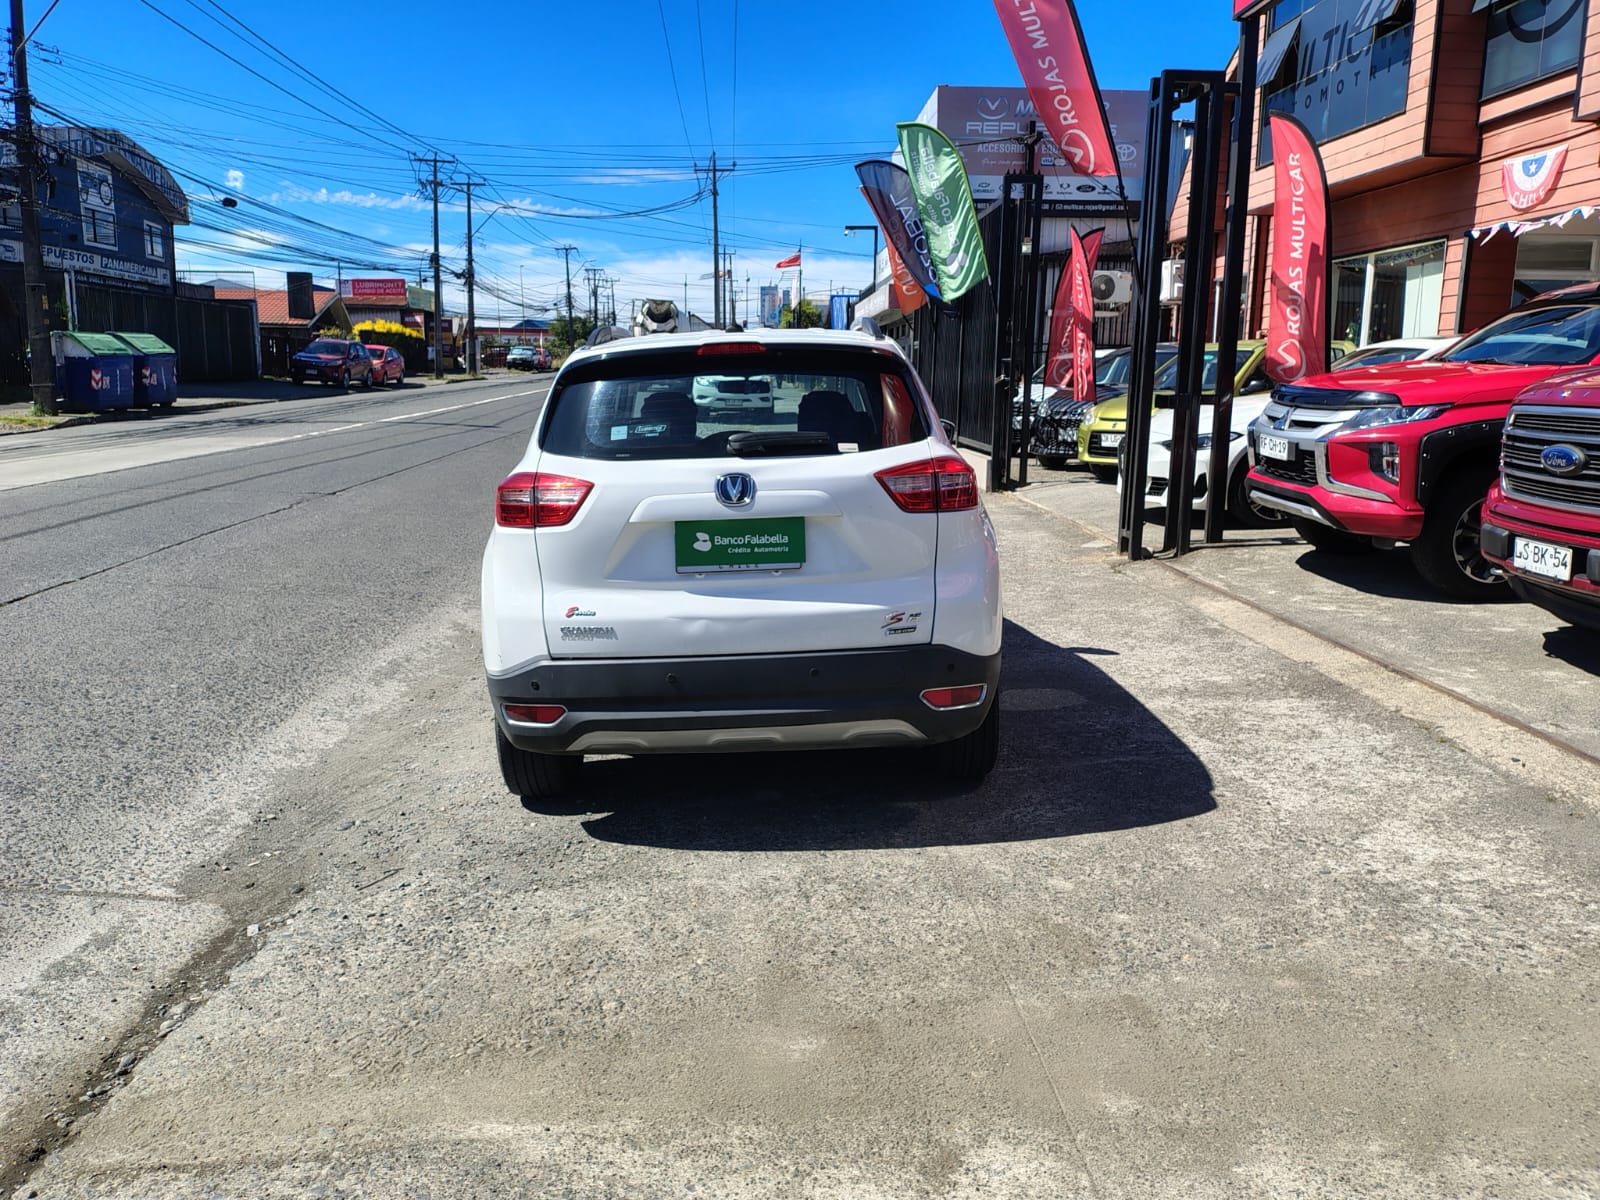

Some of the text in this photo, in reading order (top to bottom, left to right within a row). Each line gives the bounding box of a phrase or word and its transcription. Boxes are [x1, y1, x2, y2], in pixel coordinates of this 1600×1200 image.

[1038, 55, 1080, 125] ROJAS
[977, 143, 1026, 153] ACCESORIO
[1286, 152, 1305, 335] ROJAS MULTICAR
[41, 246, 95, 265] EPUESTOS
[102, 256, 158, 278] PANAMERICANA
[1546, 452, 1567, 467] Ford
[714, 533, 789, 545] Banco Falabella
